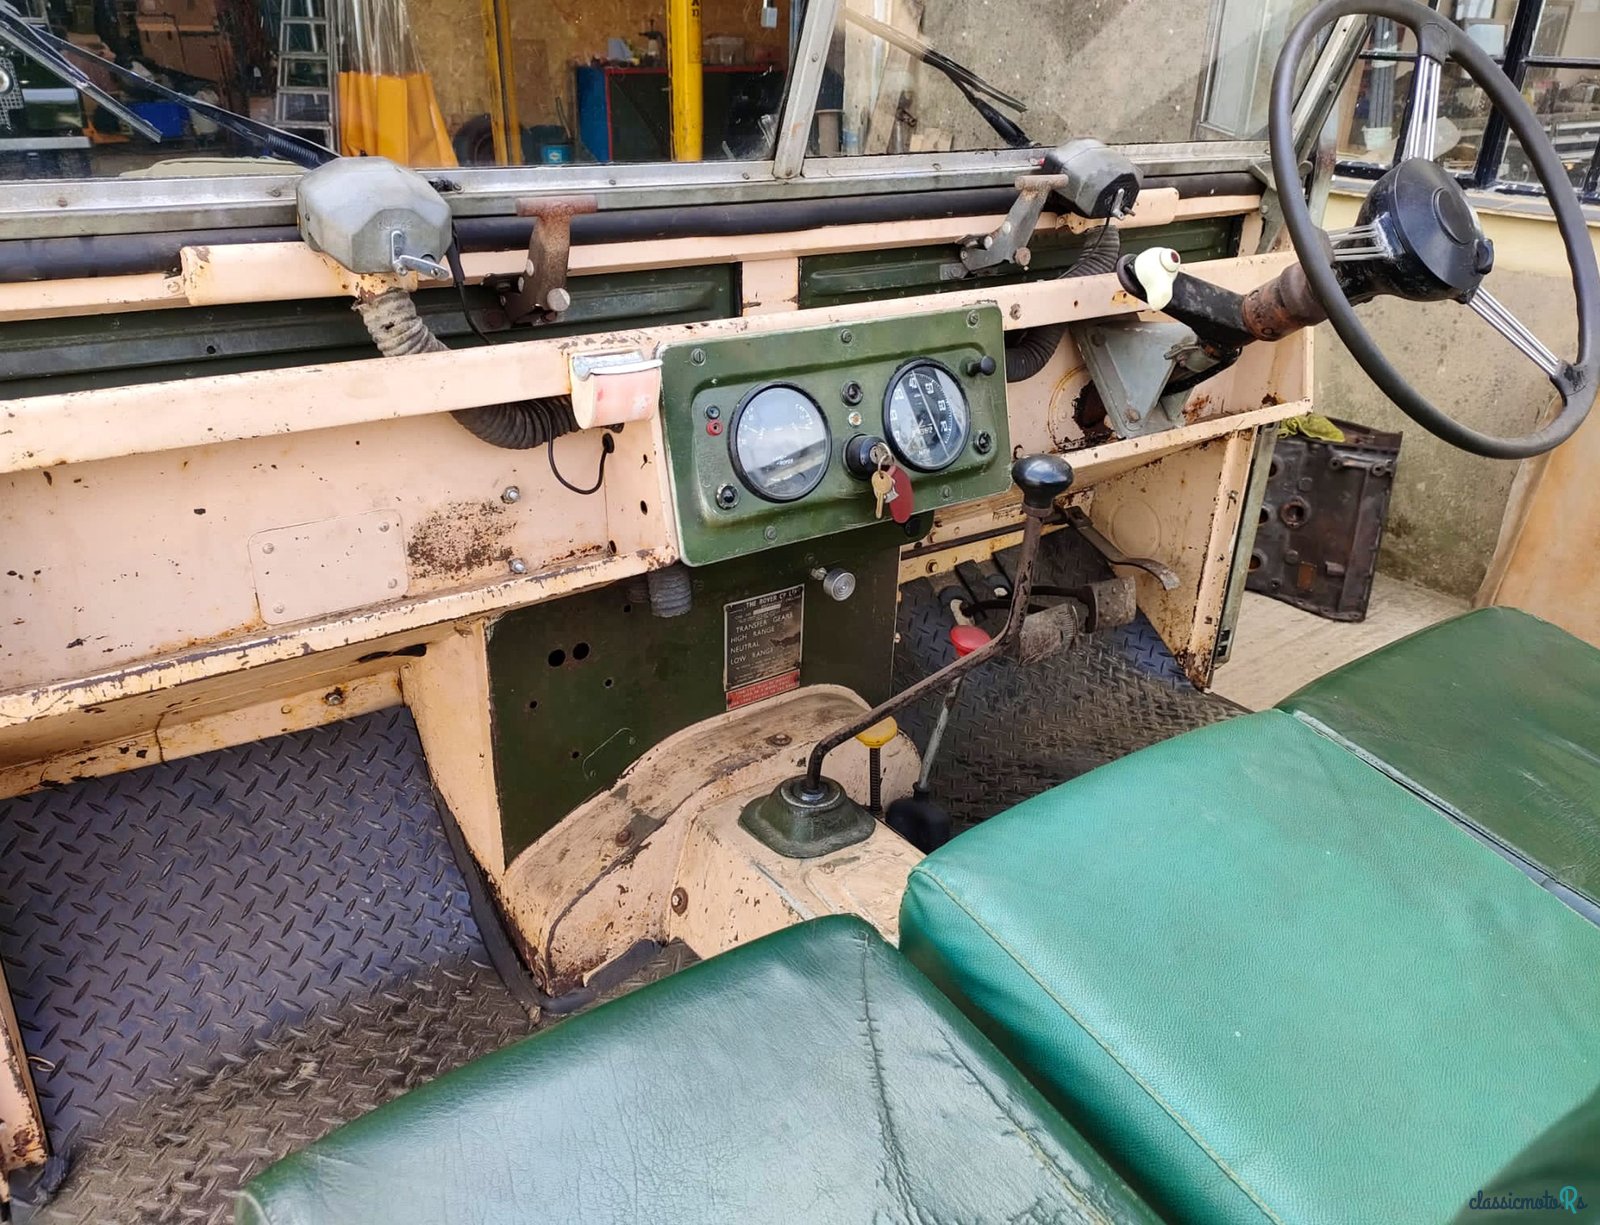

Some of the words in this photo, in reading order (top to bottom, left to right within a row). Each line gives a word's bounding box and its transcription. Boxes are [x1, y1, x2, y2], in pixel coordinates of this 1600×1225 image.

[746, 601, 757, 609] THE
[735, 619, 768, 634] TRANSFER
[773, 611, 793, 623] GEARS
[730, 634, 748, 644] HIGH
[752, 625, 775, 637] RANGE
[730, 640, 760, 654] NEUTRAL
[730, 655, 747, 665] LOW
